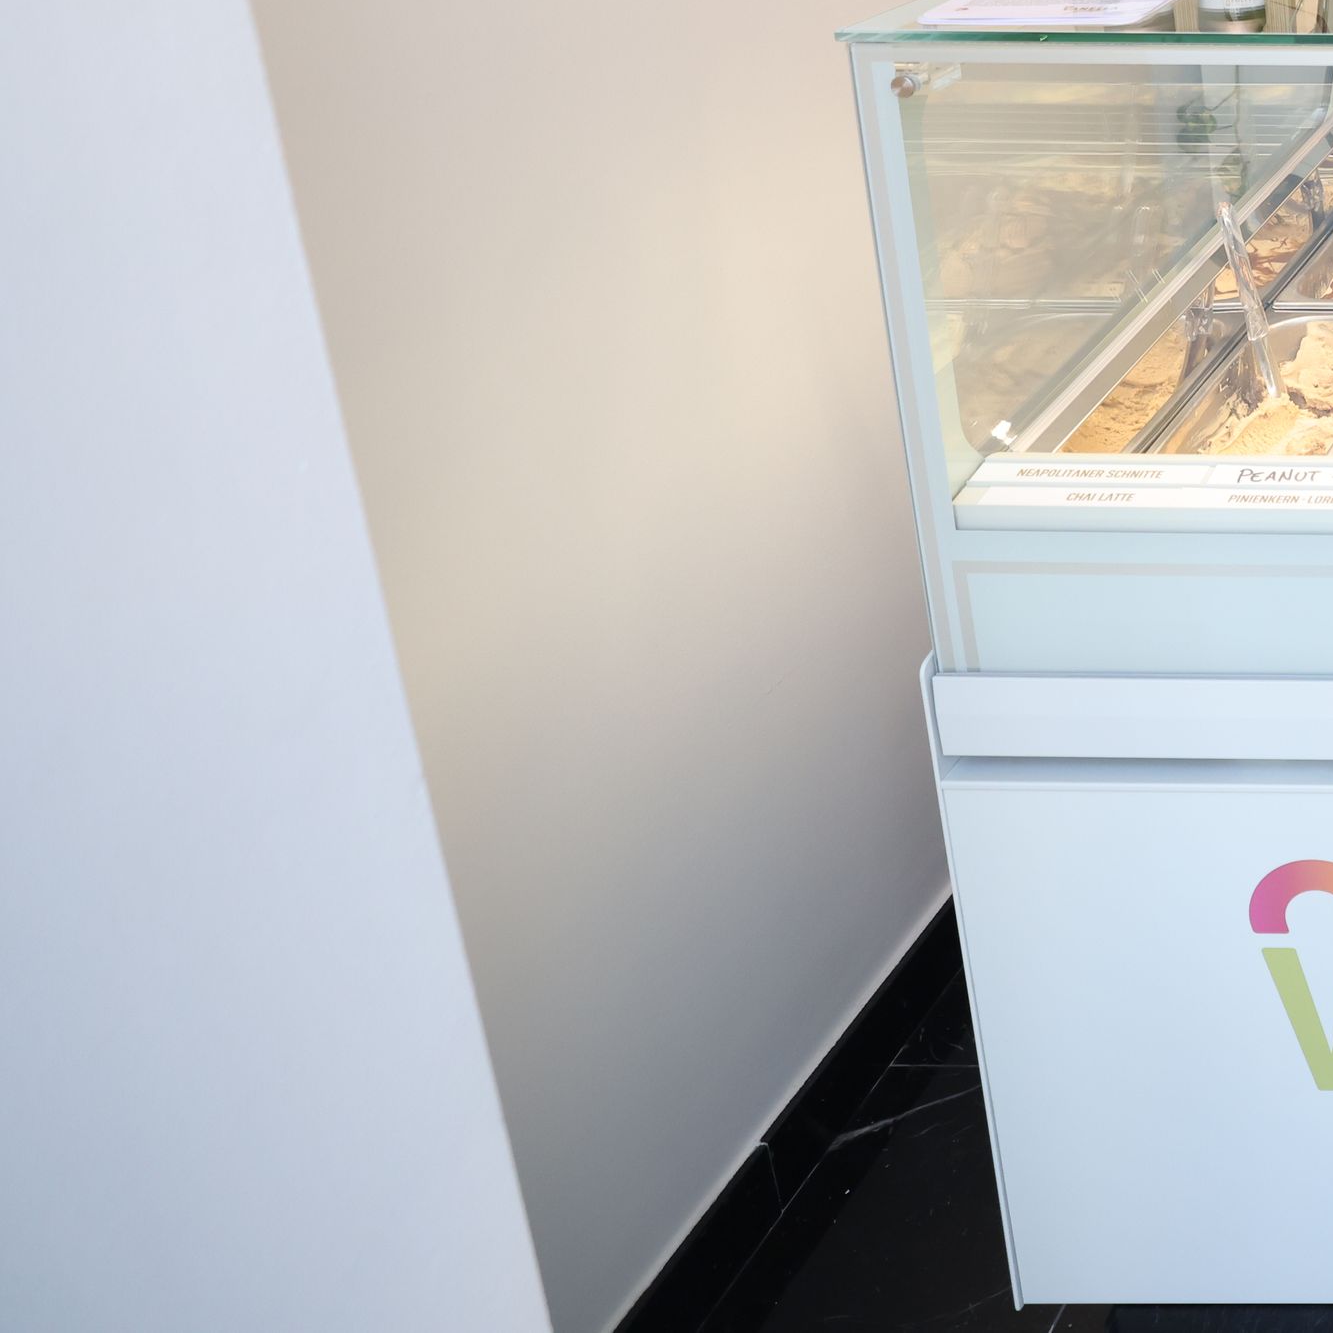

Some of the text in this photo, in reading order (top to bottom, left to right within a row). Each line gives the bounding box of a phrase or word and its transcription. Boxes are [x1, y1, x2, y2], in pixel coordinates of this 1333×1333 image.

[1016, 468, 1165, 479] NEAPOLITANER SCHNITTE
[1236, 468, 1323, 484] PEANUT
[1065, 492, 1136, 503] CHAI LATTE
[1227, 495, 1300, 505] PINIENKERN
